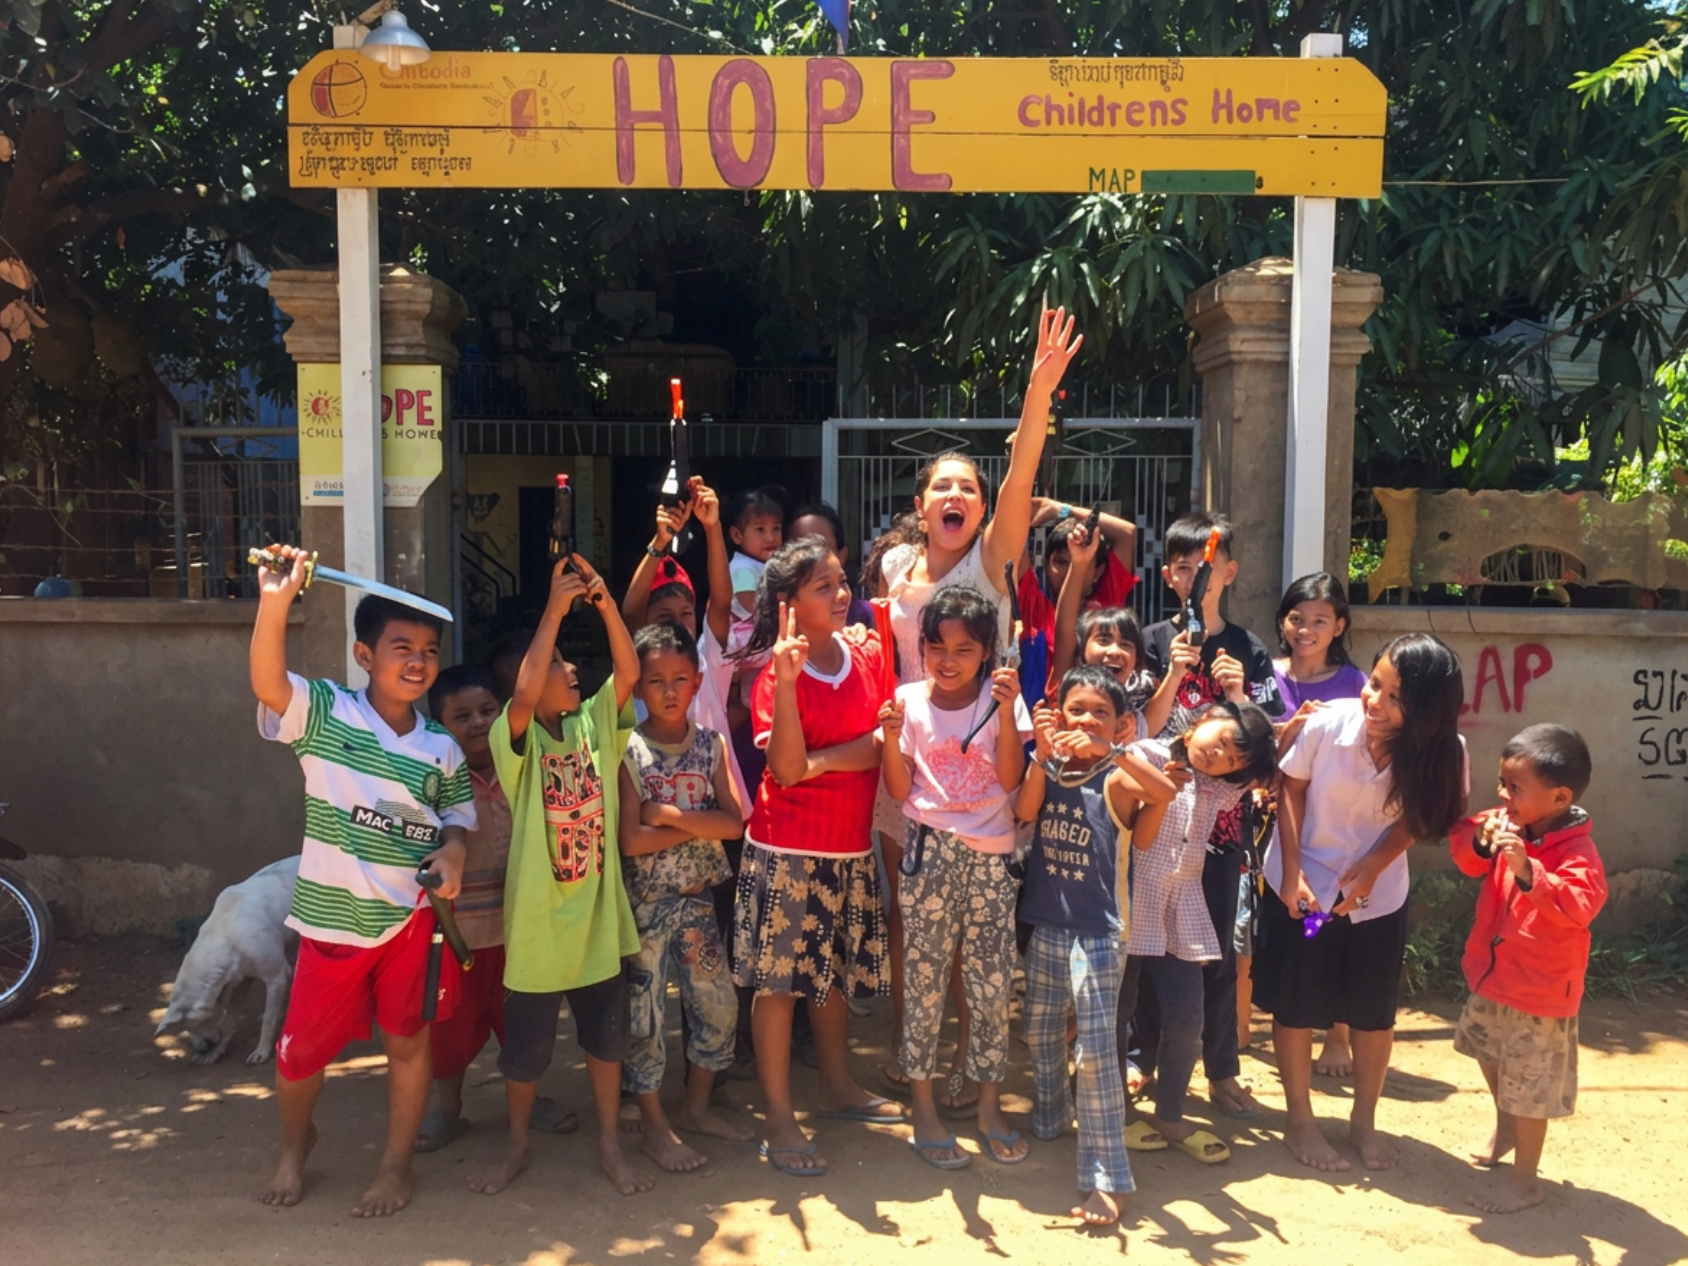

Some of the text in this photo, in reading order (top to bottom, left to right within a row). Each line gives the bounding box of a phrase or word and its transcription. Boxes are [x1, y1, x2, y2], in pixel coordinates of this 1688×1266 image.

[613, 55, 955, 191] HOPE
[1017, 88, 1301, 128] Childrens Home
[1088, 167, 1136, 192] MAP
[1459, 642, 1553, 715] AP
